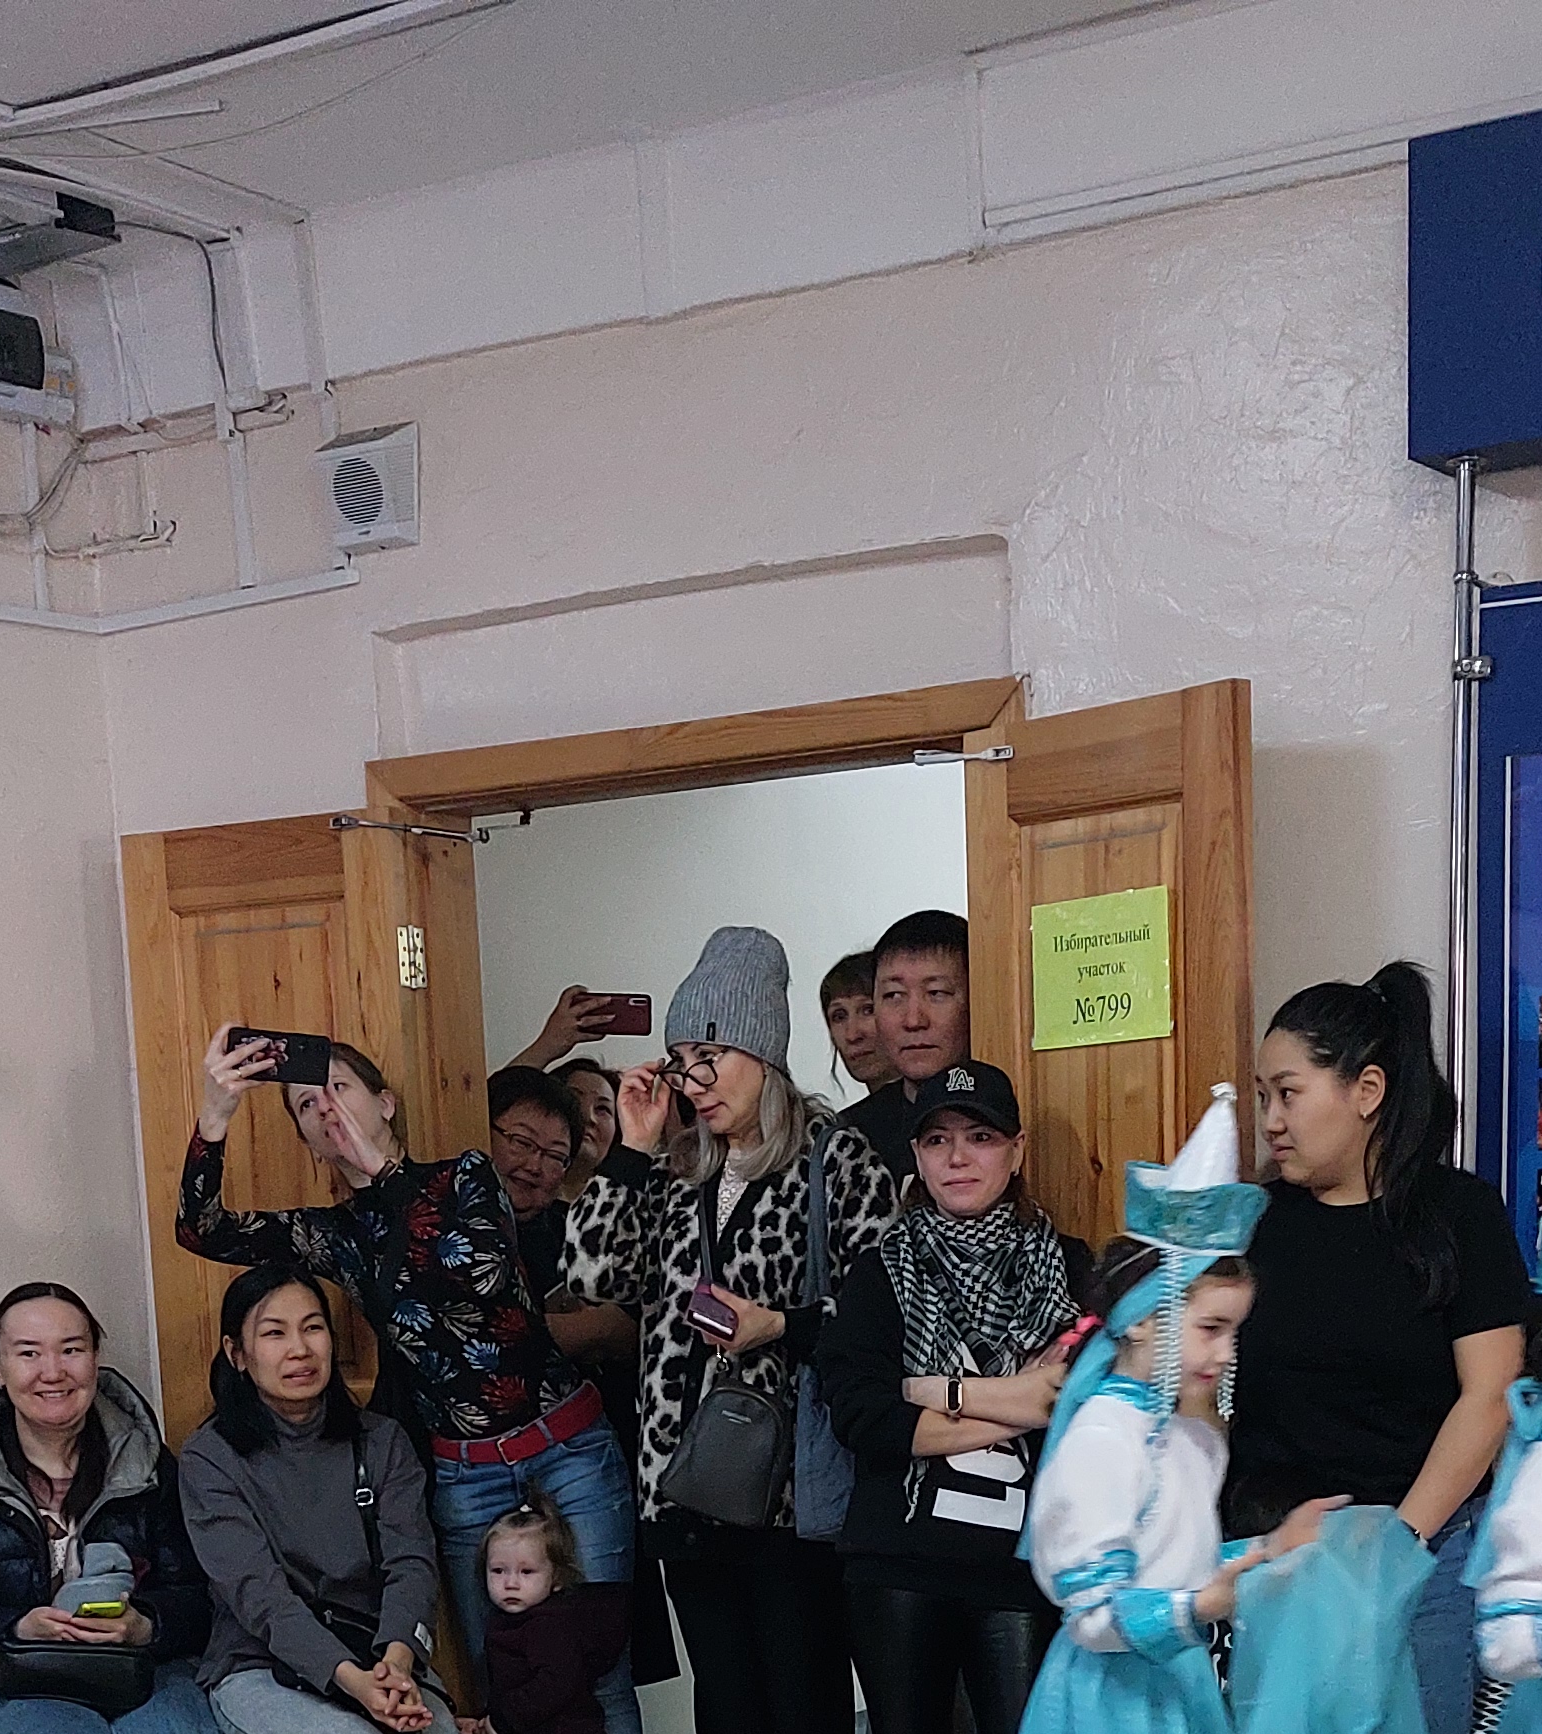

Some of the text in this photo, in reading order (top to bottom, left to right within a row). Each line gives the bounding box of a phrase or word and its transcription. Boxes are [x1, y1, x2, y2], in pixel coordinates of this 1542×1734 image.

[1053, 923, 1151, 954] Избирательный
[1077, 960, 1126, 984] участок
[1072, 991, 1132, 1025] №799
